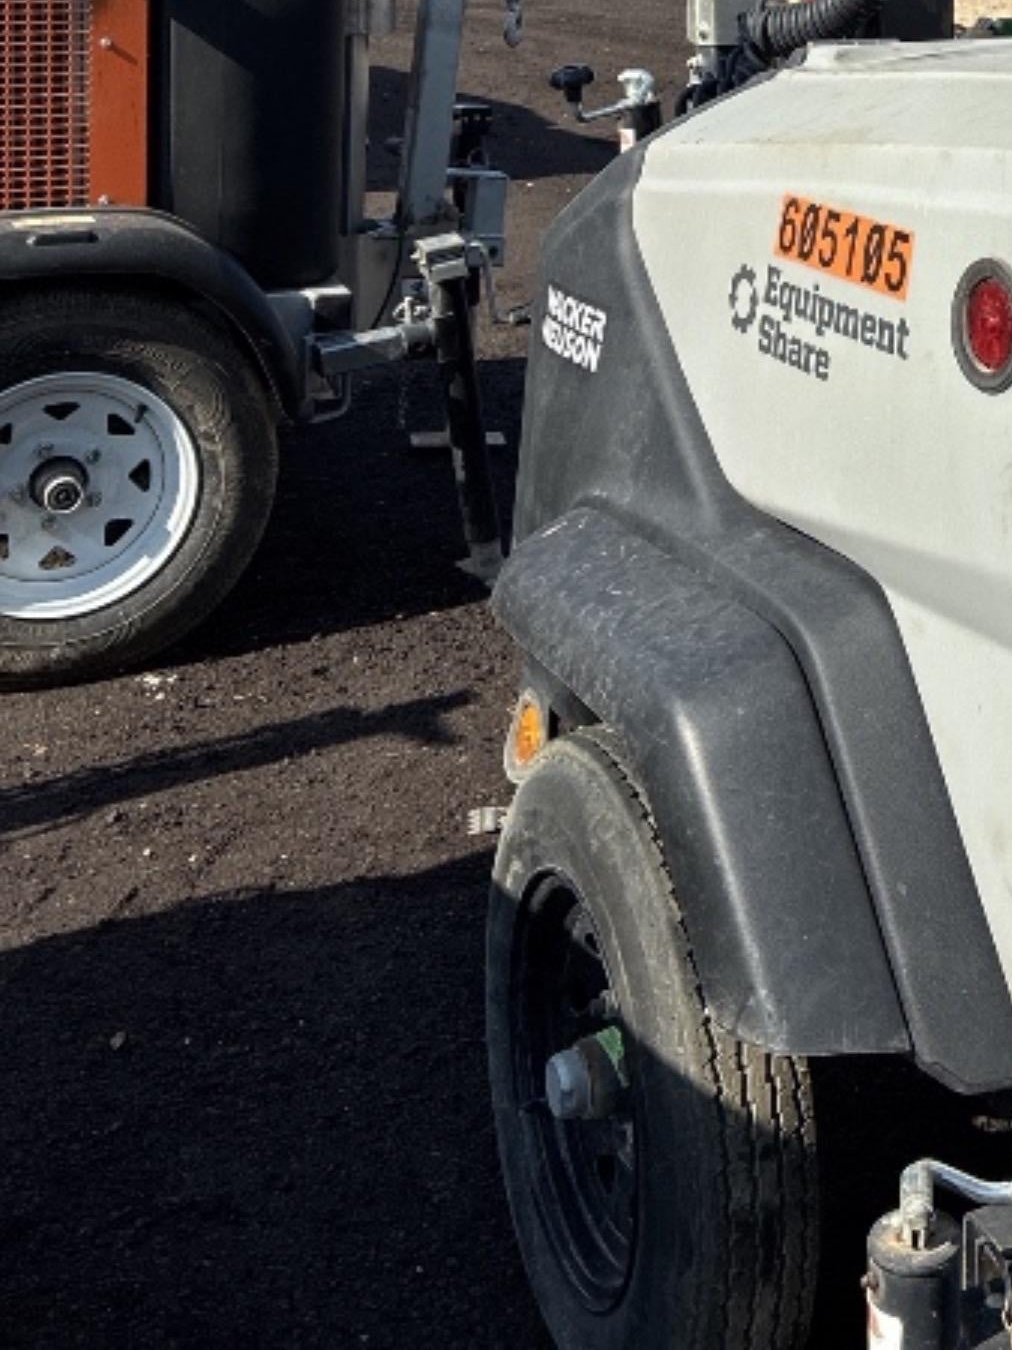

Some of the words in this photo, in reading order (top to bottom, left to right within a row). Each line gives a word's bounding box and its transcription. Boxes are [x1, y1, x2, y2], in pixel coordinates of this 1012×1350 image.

[778, 198, 910, 292] 605105
[757, 313, 831, 381] Share
[763, 265, 910, 360] Equipment
